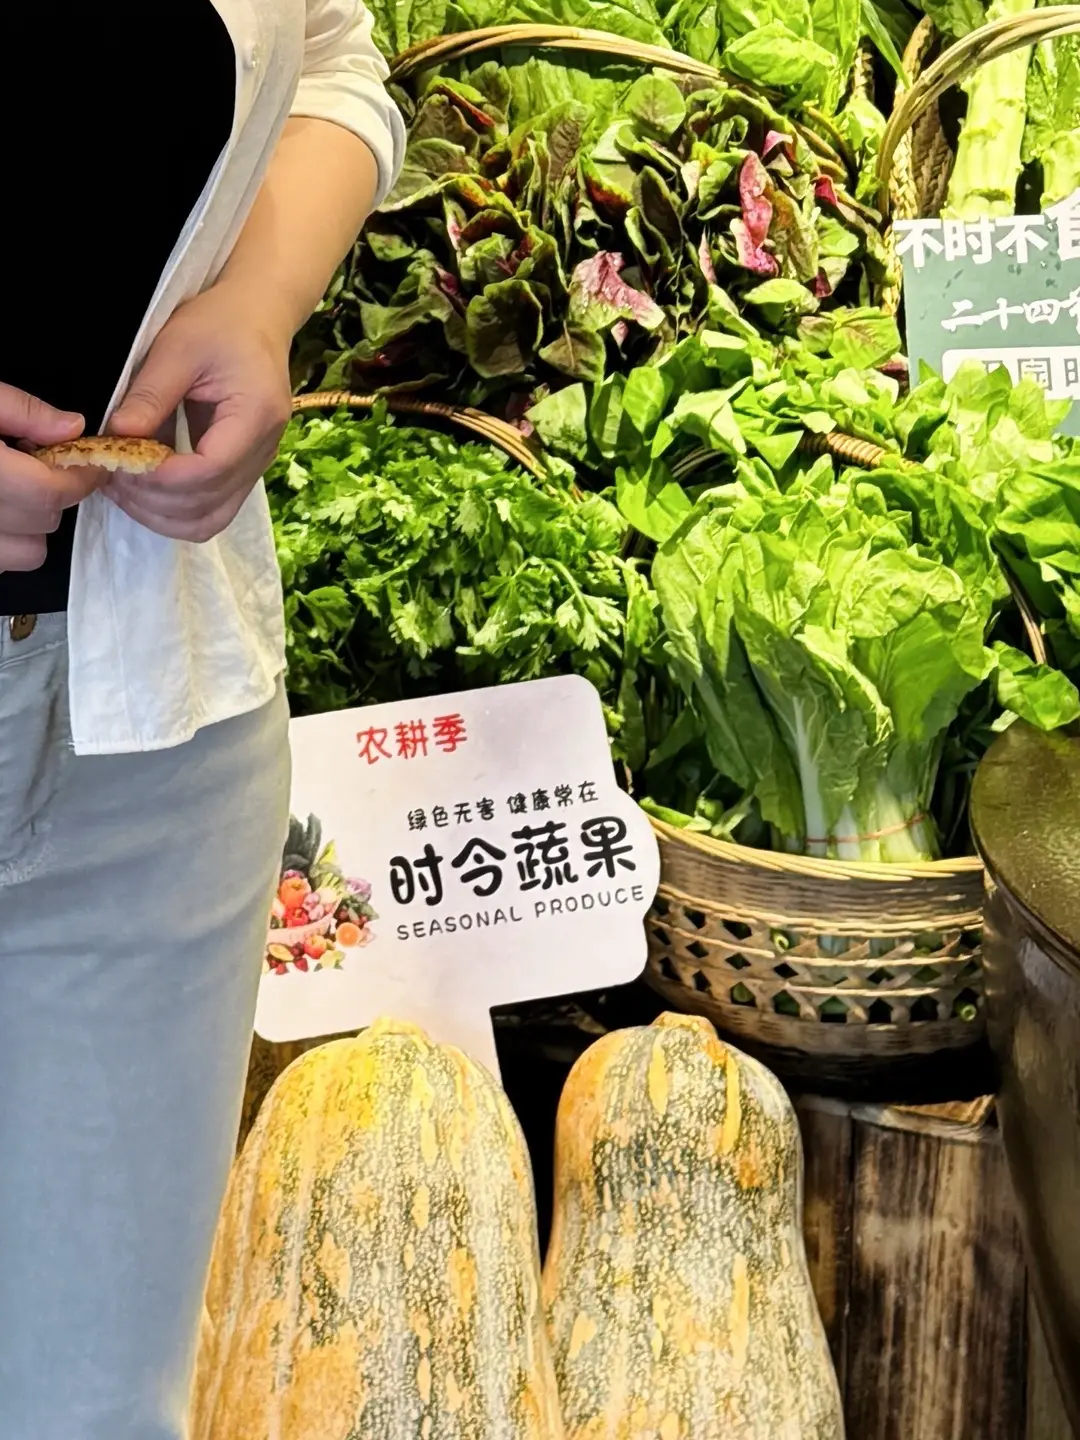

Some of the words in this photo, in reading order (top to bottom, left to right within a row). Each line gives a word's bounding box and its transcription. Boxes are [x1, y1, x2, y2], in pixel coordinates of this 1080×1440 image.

[356, 712, 468, 765] 农耕季
[407, 797, 496, 832] 绿色无害
[506, 780, 600, 815] 健康常在
[389, 816, 637, 907] 时令蔬果
[396, 906, 523, 941] SEASONAL
[534, 885, 645, 918] PRODUCE
